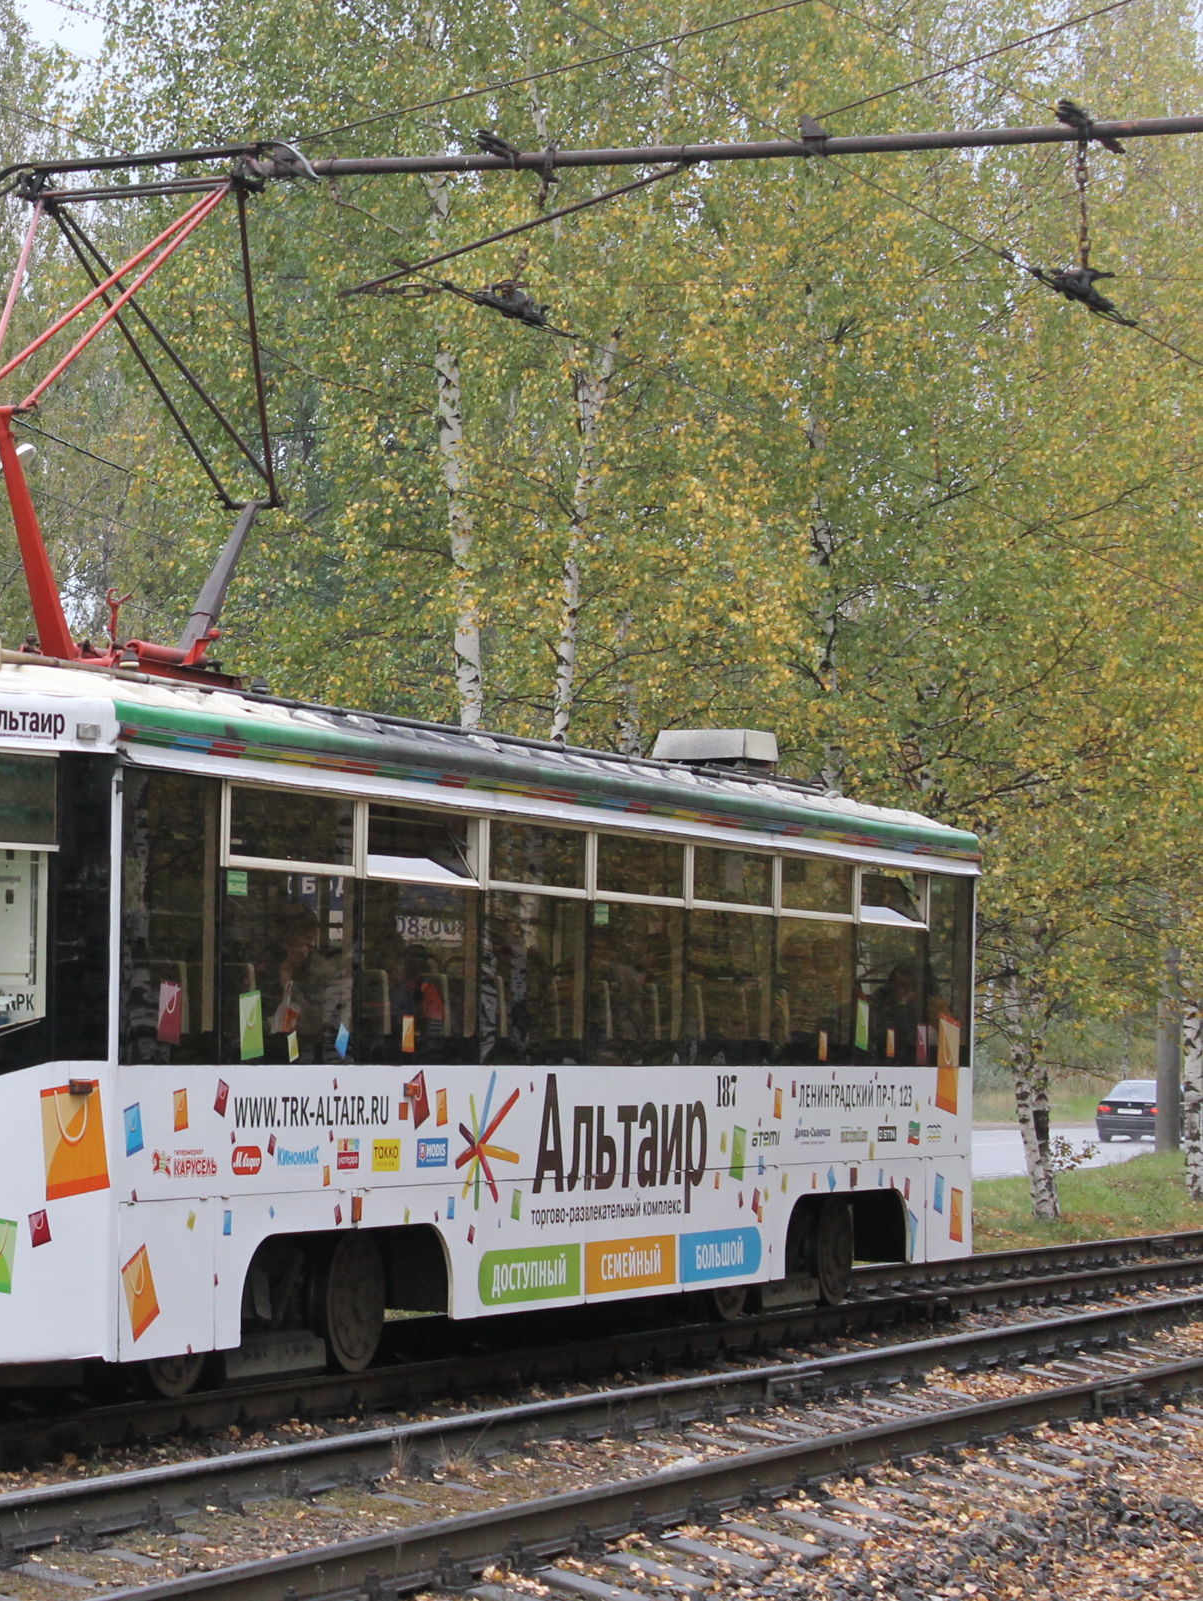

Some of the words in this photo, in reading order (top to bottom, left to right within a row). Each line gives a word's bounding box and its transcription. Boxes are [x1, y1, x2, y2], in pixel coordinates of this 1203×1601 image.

[716, 1075, 737, 1107] 187
[799, 1080, 874, 1112] ЛЕНИНГРАДСКИЙ
[899, 1085, 912, 1107] 123
[234, 1095, 390, 1128] WWW.TRK-ALTAIR.RU
[277, 1145, 319, 1167] КИНОМАКС
[532, 1073, 708, 1214] Альтаир
[173, 1158, 218, 1177] КАРУСЕЛЬ
[531, 1198, 641, 1229] торгово-развлекательный
[643, 1199, 682, 1217] комплекс
[600, 1243, 662, 1281] СЕМЕЙНЫЙ
[695, 1235, 744, 1270] БОЛЬШОЙ
[491, 1252, 567, 1298] ДОСТУПНЫЙ
